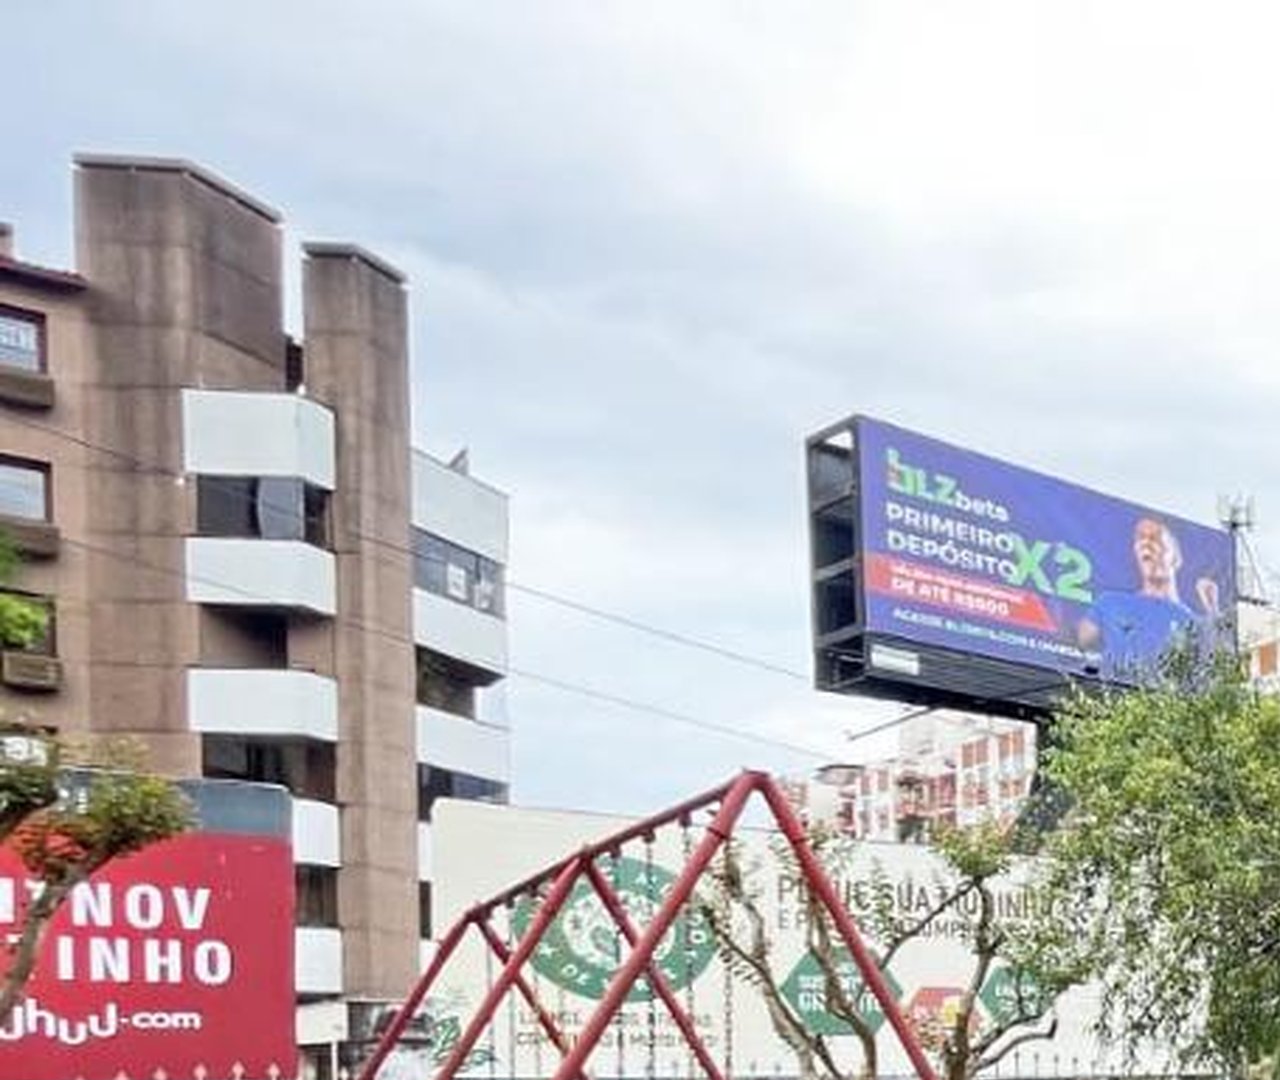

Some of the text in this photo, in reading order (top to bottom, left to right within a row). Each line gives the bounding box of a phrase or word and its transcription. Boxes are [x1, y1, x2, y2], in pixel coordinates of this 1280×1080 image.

[886, 501, 1014, 552] PRIMEIRO
[888, 529, 1019, 580] DEPÓSITO
[1011, 532, 1093, 604] X2
[73, 881, 211, 930] NOV
